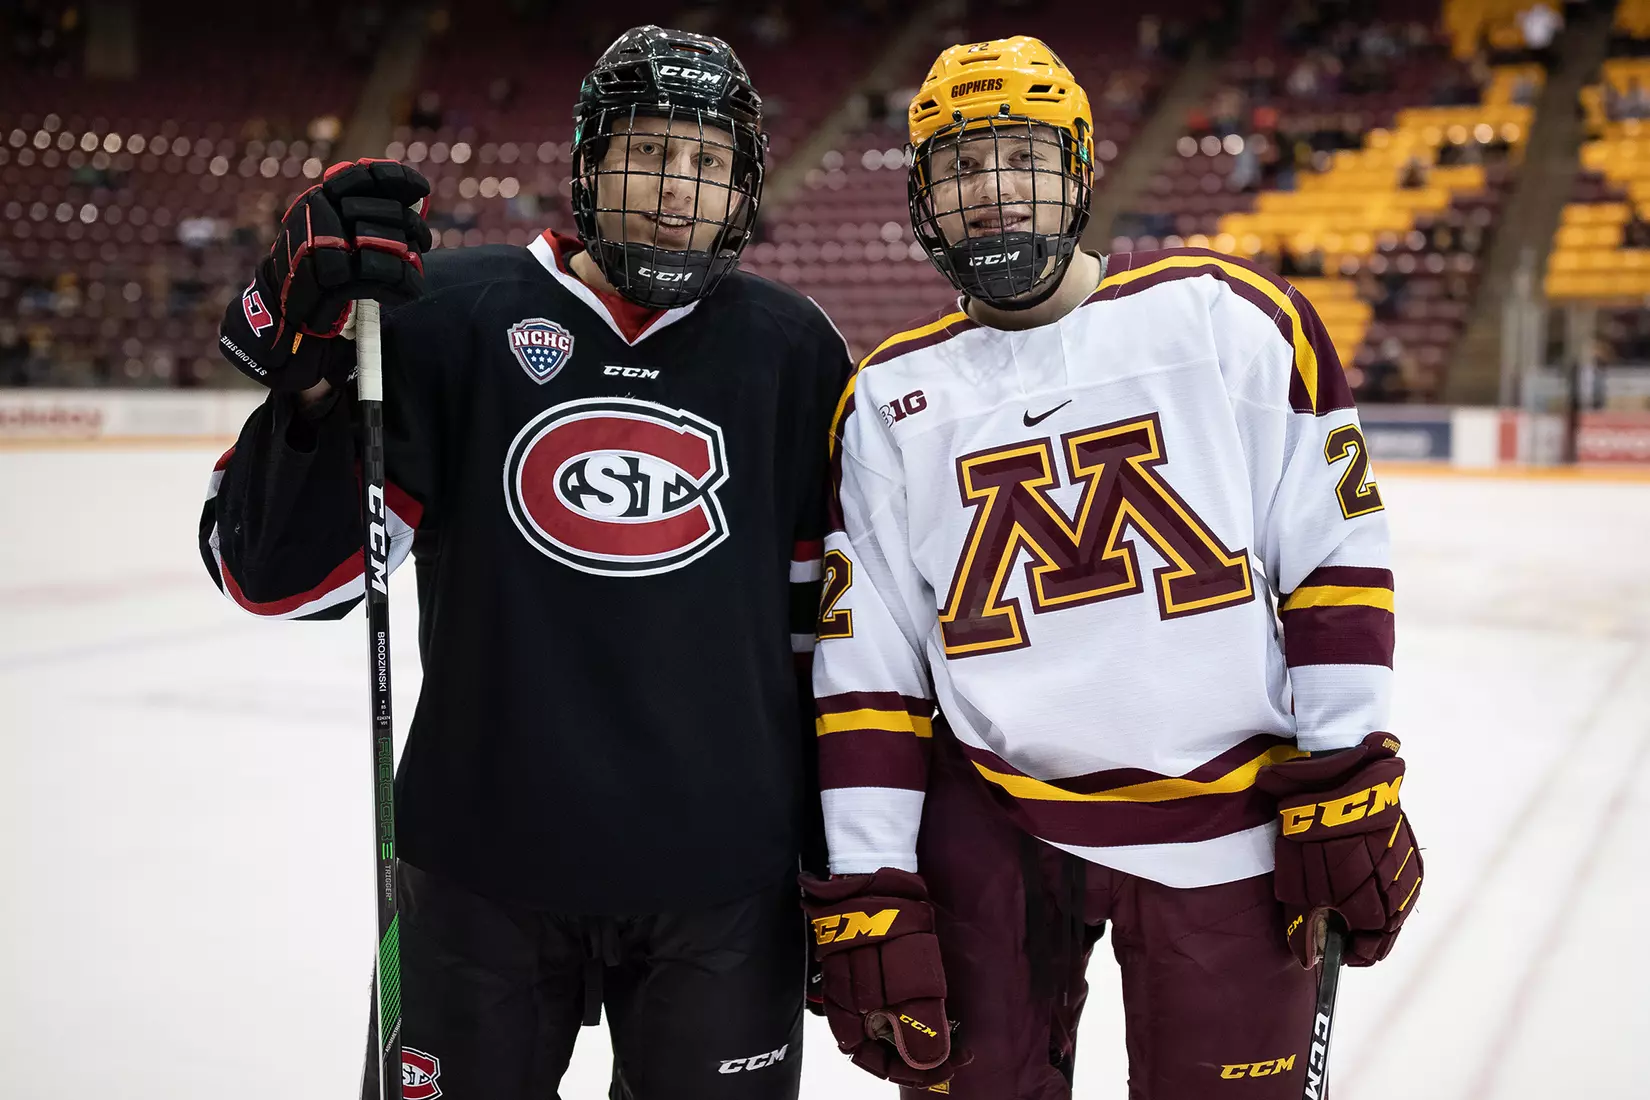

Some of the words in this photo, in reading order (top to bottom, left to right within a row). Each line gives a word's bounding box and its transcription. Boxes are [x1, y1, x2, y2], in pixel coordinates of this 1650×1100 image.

[659, 65, 722, 84] CCM
[951, 78, 1004, 98] GOPHERS
[969, 250, 1020, 267] CCM
[637, 266, 693, 282] CCM
[220, 335, 238, 351] STATE
[512, 330, 571, 352] NCHC
[235, 349, 257, 368] CLOUD
[602, 365, 660, 380] CCM
[1324, 423, 1385, 520] 2
[368, 483, 388, 596] CCM
[938, 411, 1255, 661] M
[377, 631, 387, 692] BRODZINSKI
[1279, 775, 1403, 836] CCM
[812, 909, 900, 945] CM
[899, 1013, 938, 1038] CCM
[718, 1043, 789, 1074] CCM
[1220, 1053, 1296, 1079] CCM
[1305, 1012, 1330, 1100] CCM
